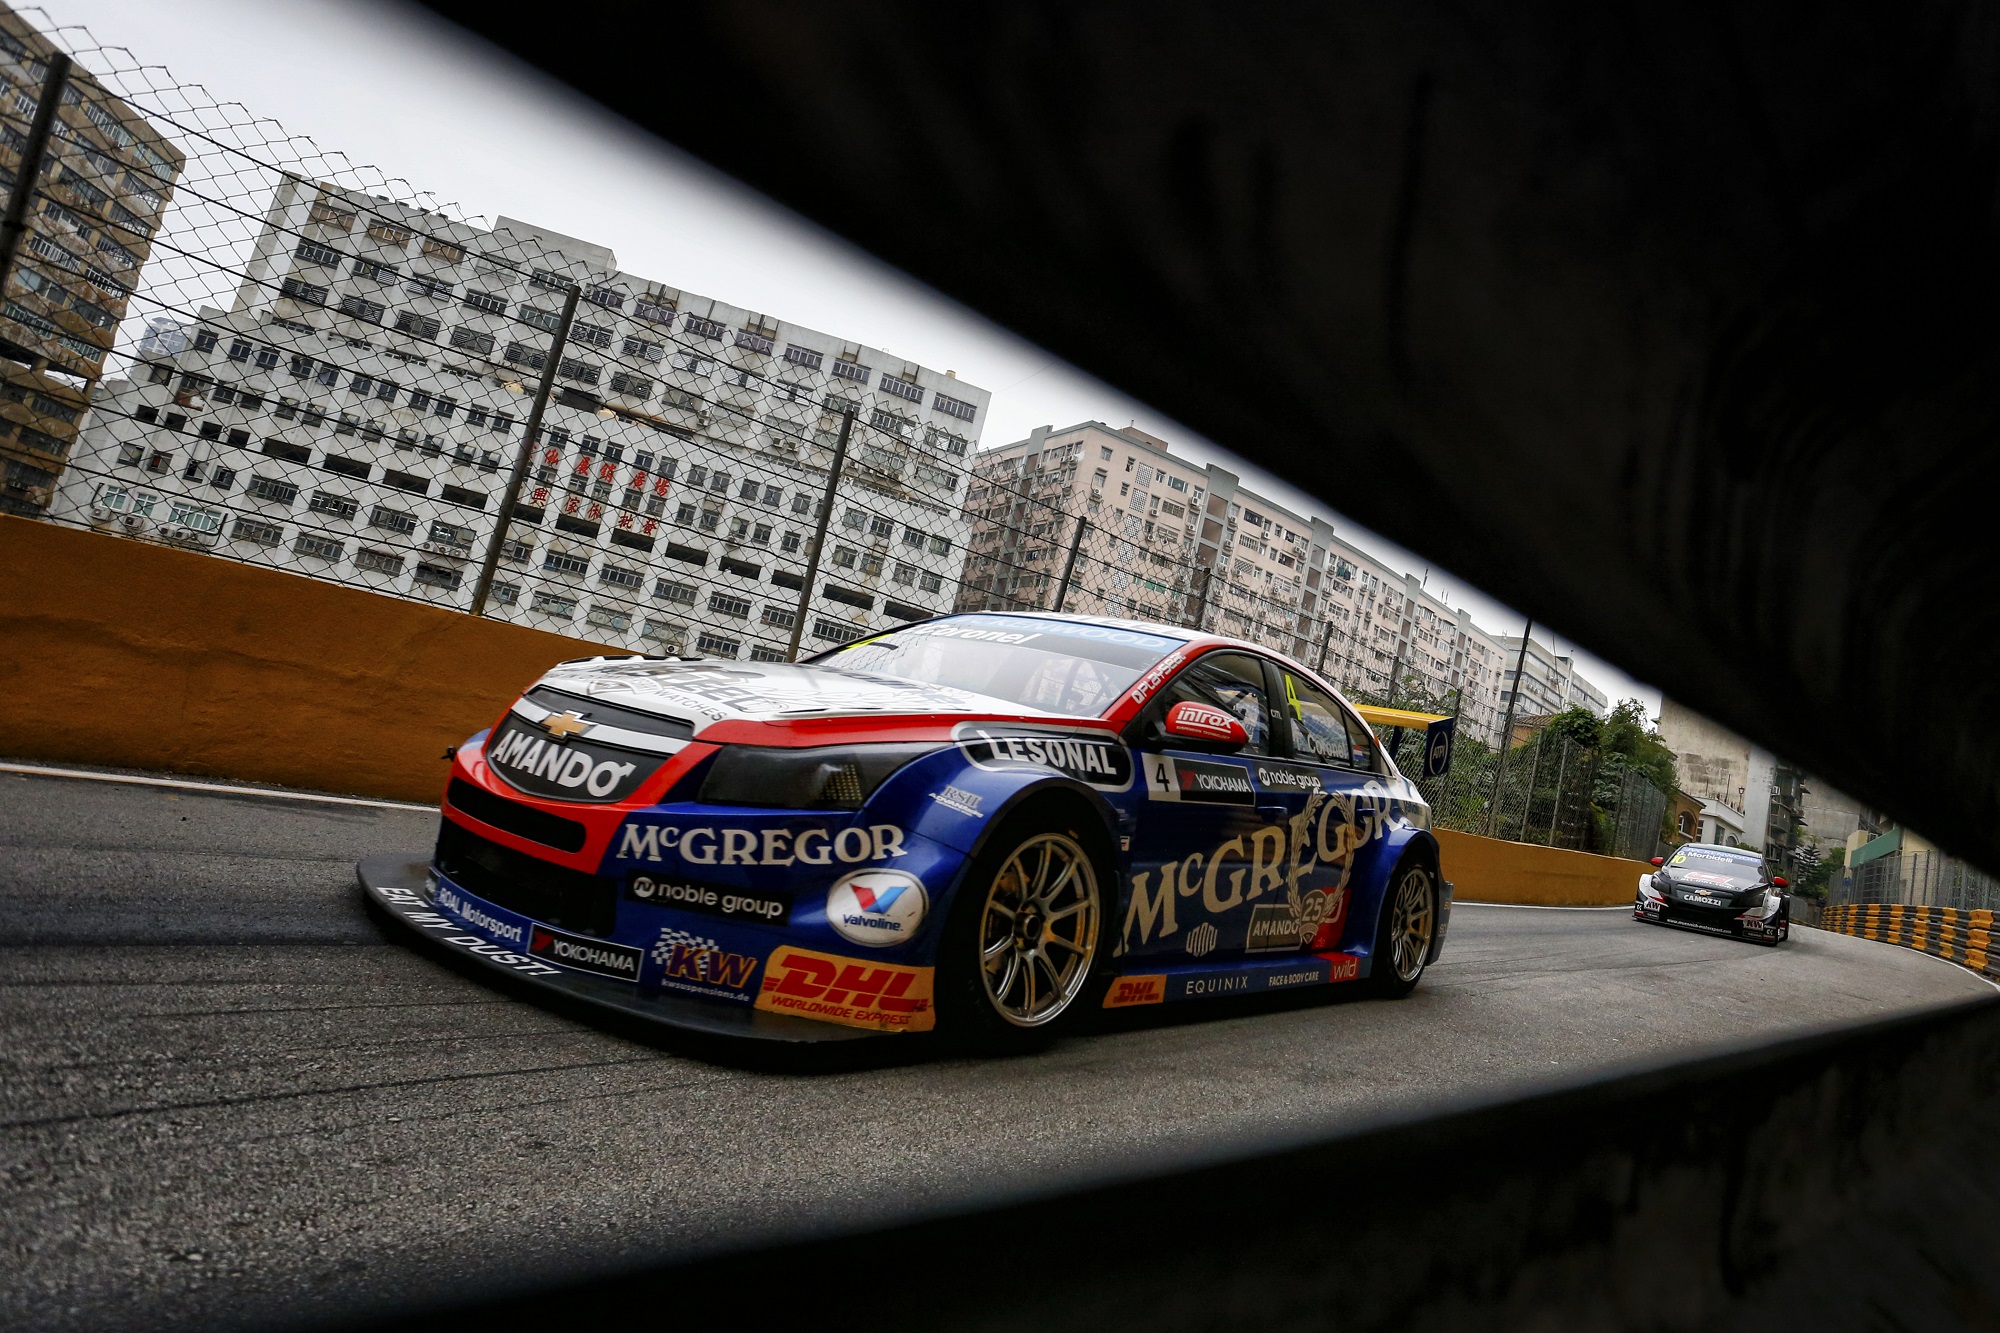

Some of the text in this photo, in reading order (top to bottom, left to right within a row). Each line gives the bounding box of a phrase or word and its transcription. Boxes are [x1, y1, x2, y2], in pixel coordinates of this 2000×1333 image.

[528, 443, 671, 497] 俬展銷廣場
[516, 485, 658, 537] 興傢俬批發
[1285, 675, 1302, 720] 4
[490, 729, 637, 798] AMANDO
[976, 730, 1118, 776] LESONAL
[1155, 762, 1170, 793] 4
[1195, 773, 1252, 793] YOKOHAMA
[1269, 771, 1321, 790] noble group
[615, 824, 908, 867] McGREGOR
[1670, 854, 1687, 864] 10
[1687, 852, 1733, 864] Morbidelli
[1113, 780, 1404, 958] McGREGOR
[657, 881, 783, 919] noble group
[1301, 897, 1324, 922] 25
[1683, 894, 1722, 907] CAMOZZI
[376, 887, 563, 976] EAT MY DUST!
[462, 902, 523, 943] Motorsport
[843, 914, 901, 932] Valvoline
[553, 939, 636, 972] YOKOHAMA
[664, 943, 758, 988] KW
[1333, 958, 1358, 981] wild
[660, 978, 750, 1002] kwsuspensions.de
[774, 953, 917, 1013] DHL
[1113, 981, 1159, 1003] DHL
[1185, 976, 1249, 995] EQUINIX
[772, 995, 912, 1025] WORLDWIDE EXPRESS
